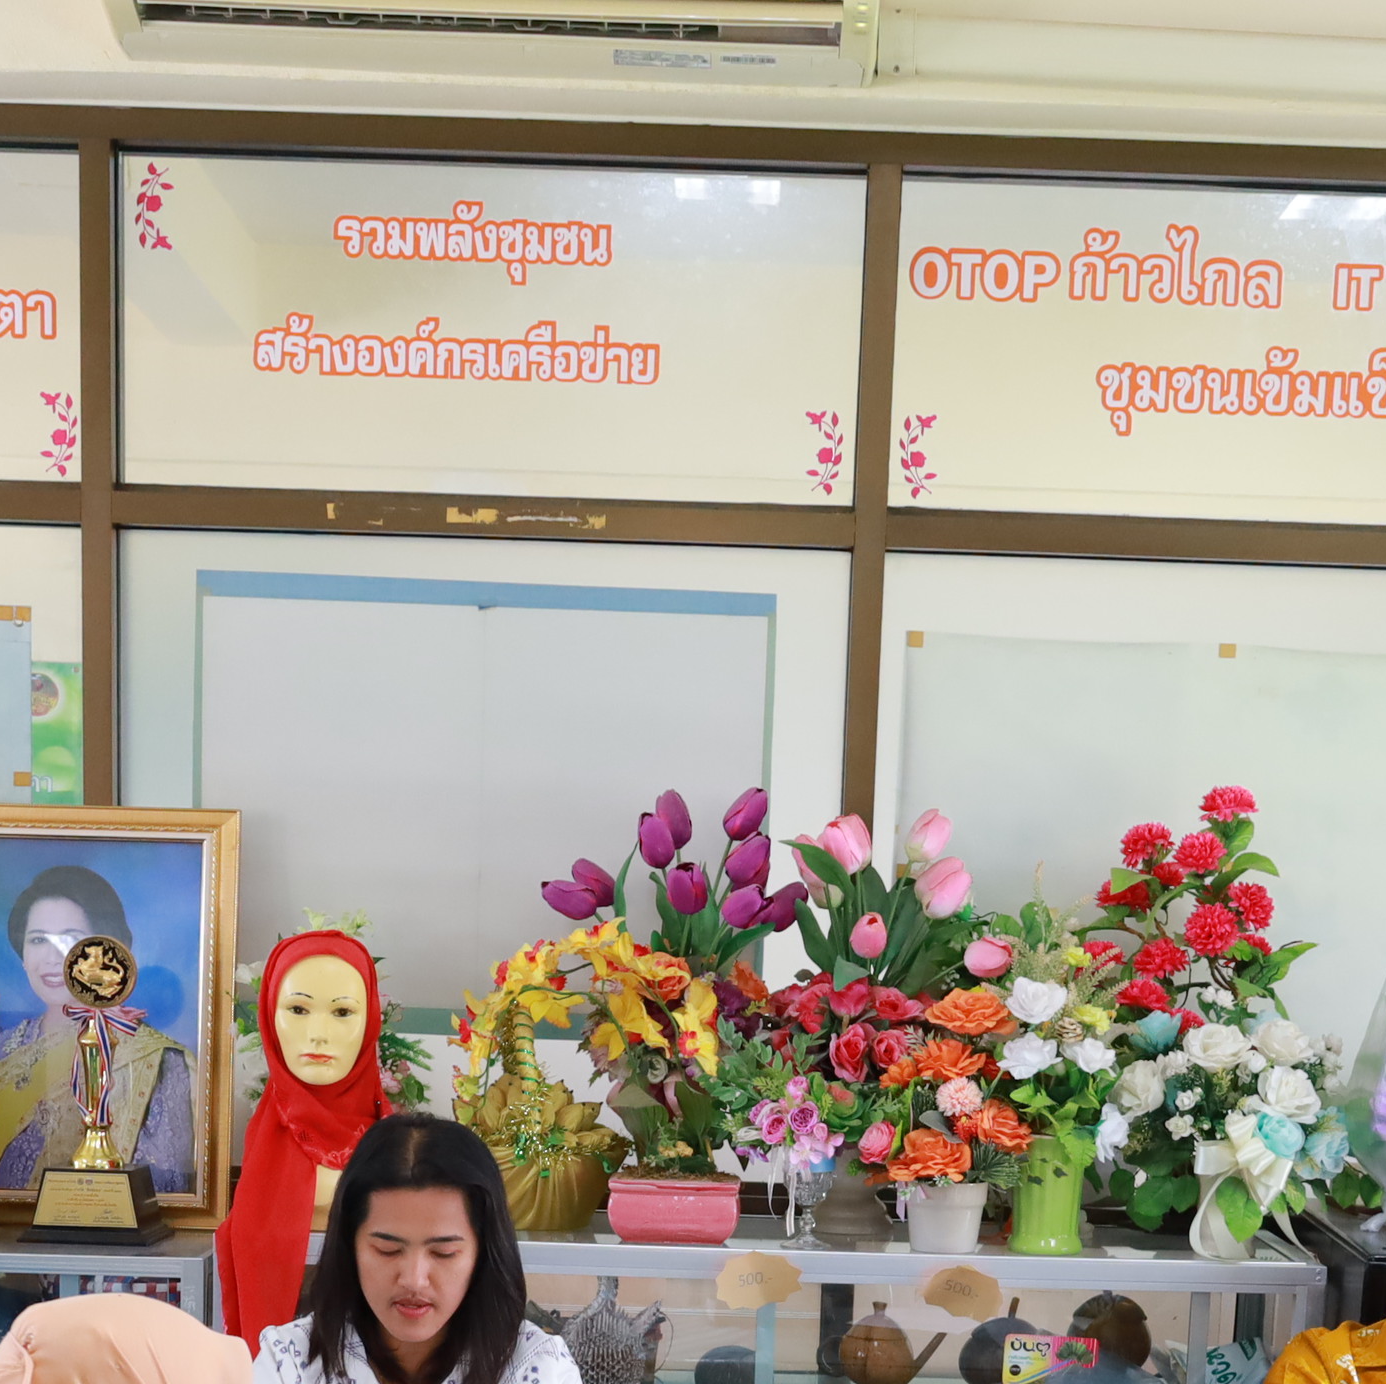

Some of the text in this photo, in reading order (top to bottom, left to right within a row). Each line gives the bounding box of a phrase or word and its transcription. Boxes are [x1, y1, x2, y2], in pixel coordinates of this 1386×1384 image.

[334, 201, 612, 286] รวมพลังชุมชน
[910, 247, 1061, 302] OTOP
[1069, 224, 1282, 308] ก้าวไกล
[1333, 264, 1384, 311] IT
[254, 311, 660, 383] สร้างองค์กรเครือข่าย
[738, 1271, 774, 1288] 500.-
[943, 1278, 979, 1299] 500.-
